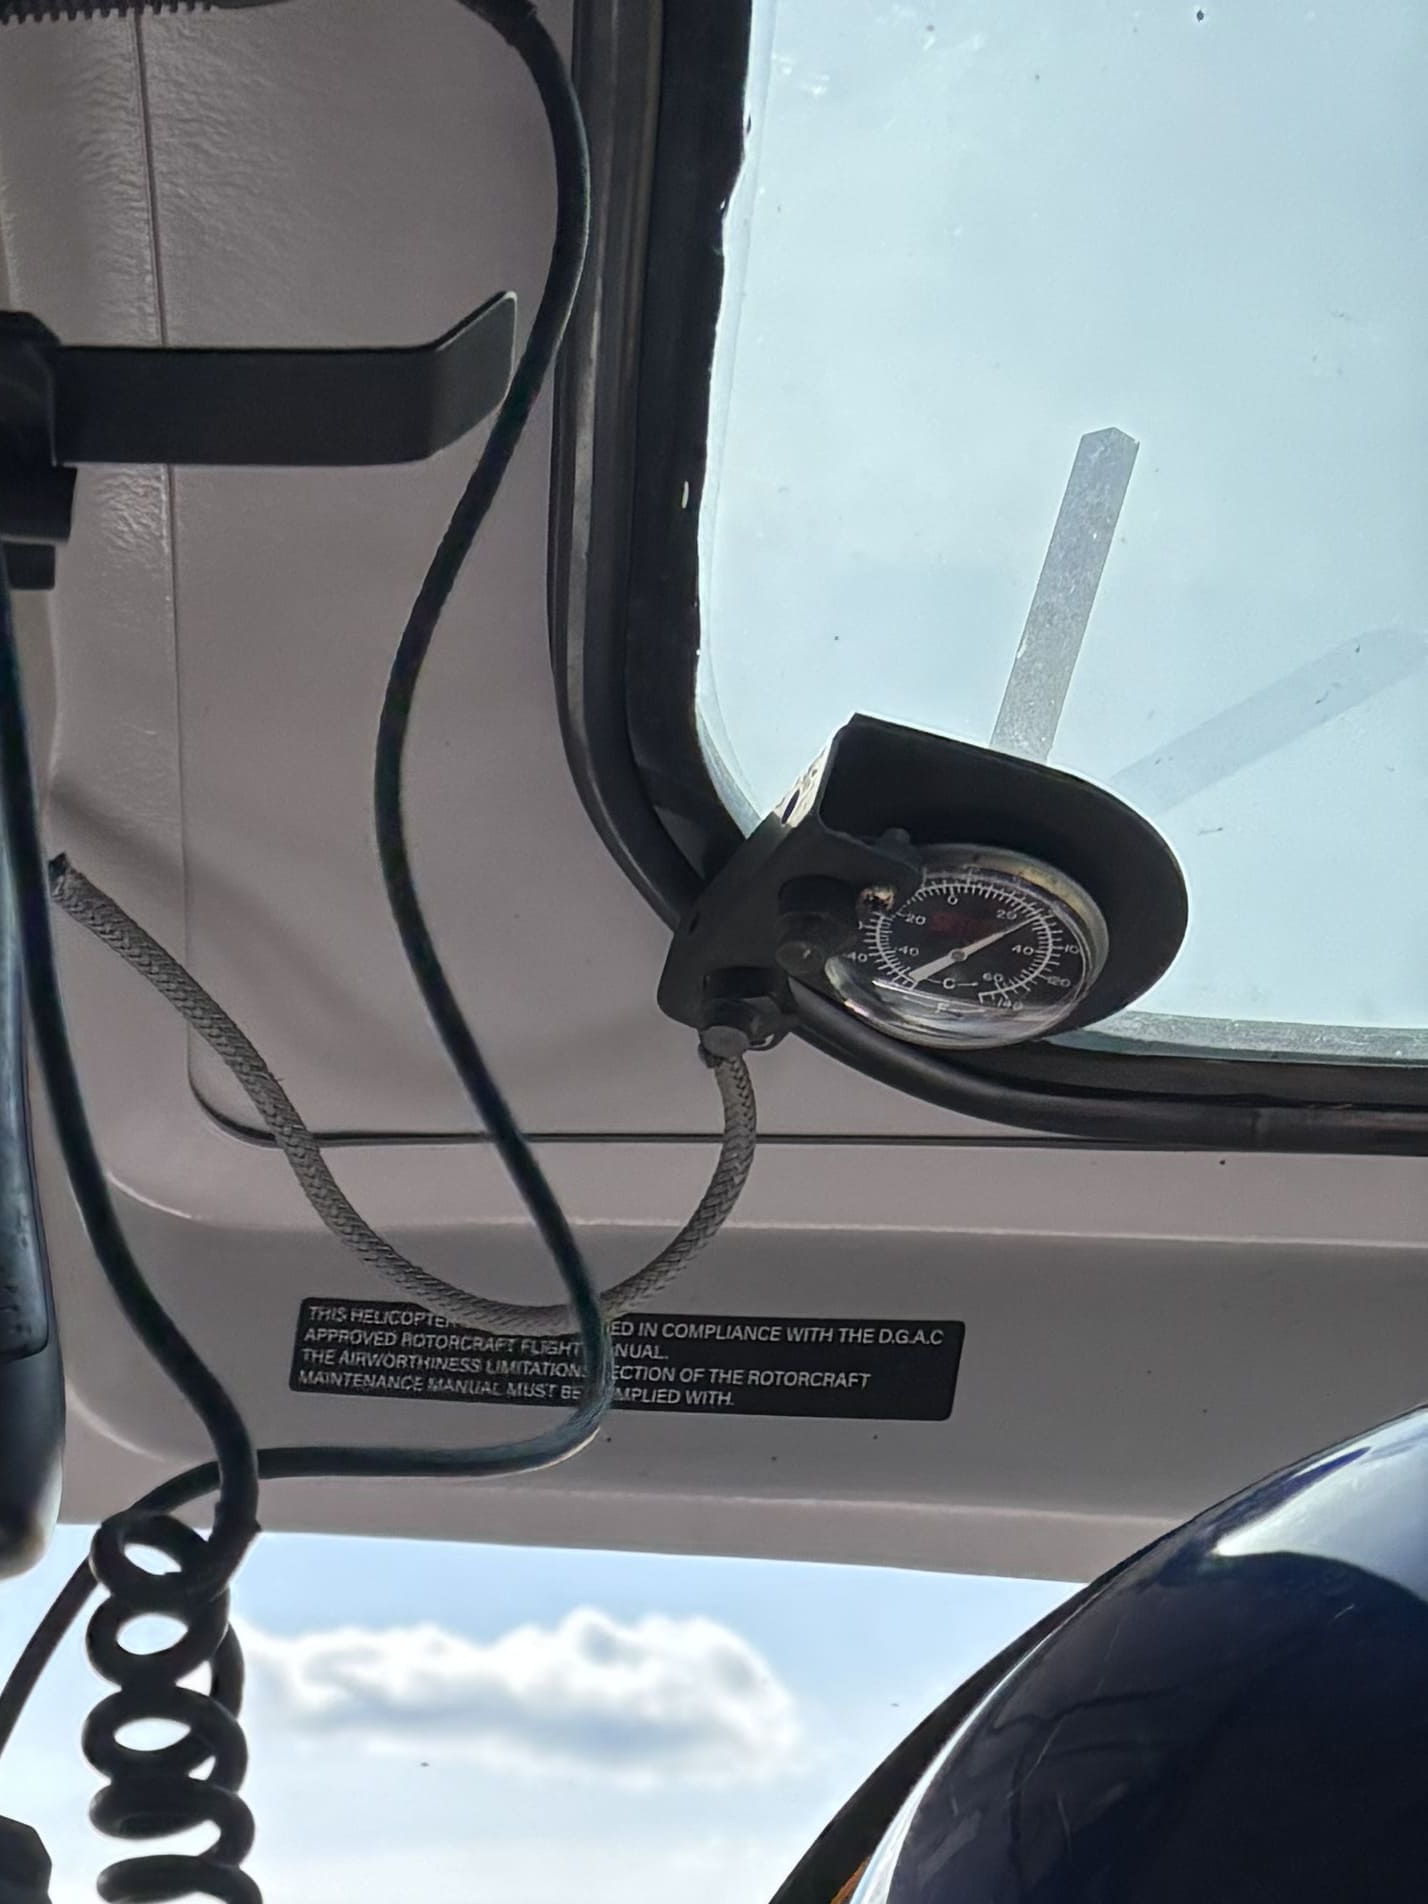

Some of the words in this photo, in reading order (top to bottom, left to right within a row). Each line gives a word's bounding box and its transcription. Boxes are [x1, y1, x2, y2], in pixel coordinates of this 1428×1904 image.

[308, 1306, 348, 1323] THIS
[302, 1327, 397, 1348] APPROVED
[402, 1331, 518, 1354] ROTORCRAFT
[520, 1340, 583, 1357] FLIGHT
[613, 1343, 670, 1361] NUAL.
[638, 1321, 660, 1338] IN
[662, 1322, 782, 1342] COMPLIANCE
[786, 1326, 834, 1344] WITH
[838, 1328, 875, 1344] THE
[301, 1347, 339, 1365] THE
[340, 1350, 482, 1374] AIRWORTHINESS
[610, 1365, 676, 1384] ECTION
[679, 1367, 706, 1384] OF
[708, 1368, 745, 1387] THE
[747, 1370, 873, 1390] ROTORCRAFT
[297, 1369, 425, 1393] MAINTENANCE
[427, 1377, 505, 1397] MANUAL
[506, 1381, 556, 1399] MUST
[559, 1385, 583, 1401] BE
